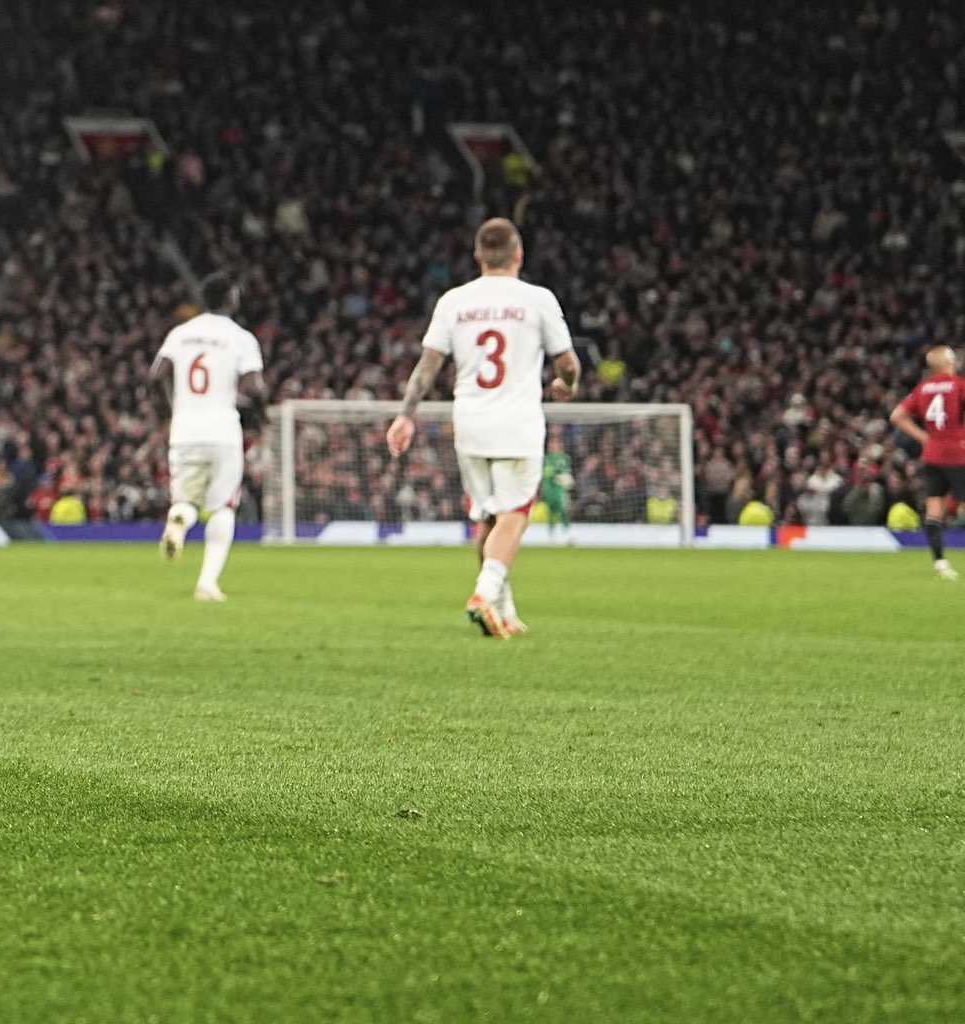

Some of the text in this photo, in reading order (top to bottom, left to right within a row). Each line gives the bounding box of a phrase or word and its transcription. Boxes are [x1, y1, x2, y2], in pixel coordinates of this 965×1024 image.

[189, 353, 210, 395] 6
[476, 329, 506, 389] 3
[925, 394, 947, 431] 4
